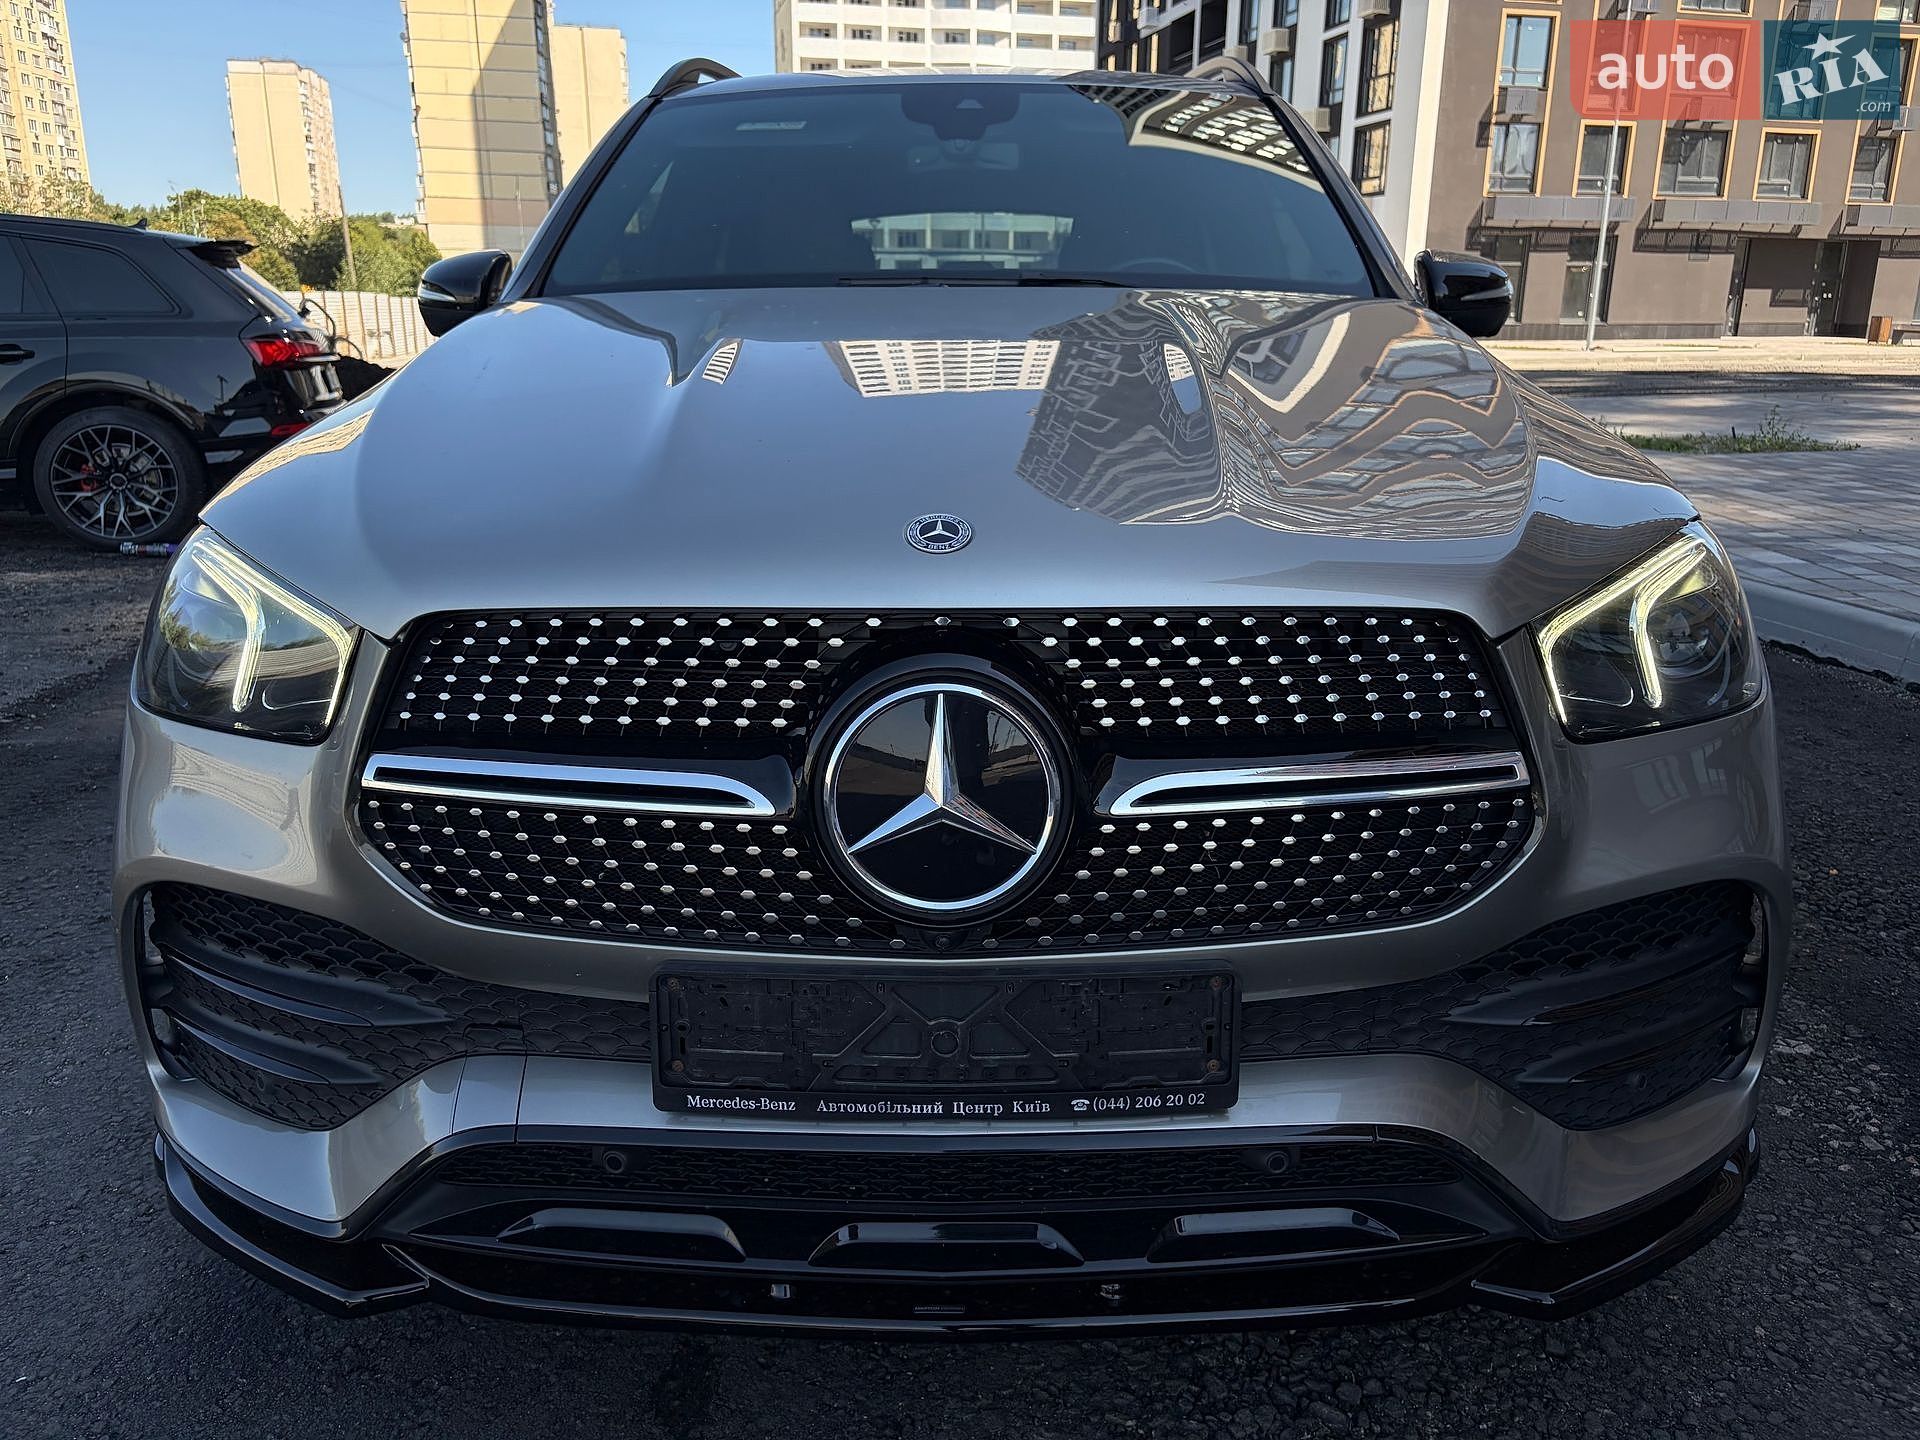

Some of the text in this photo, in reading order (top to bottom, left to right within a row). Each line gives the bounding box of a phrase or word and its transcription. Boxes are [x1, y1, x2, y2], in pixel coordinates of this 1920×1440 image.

[686, 1092, 1205, 1116] Mercedes-Benz Автомобільний Центр Київ (044) 206 20 02
